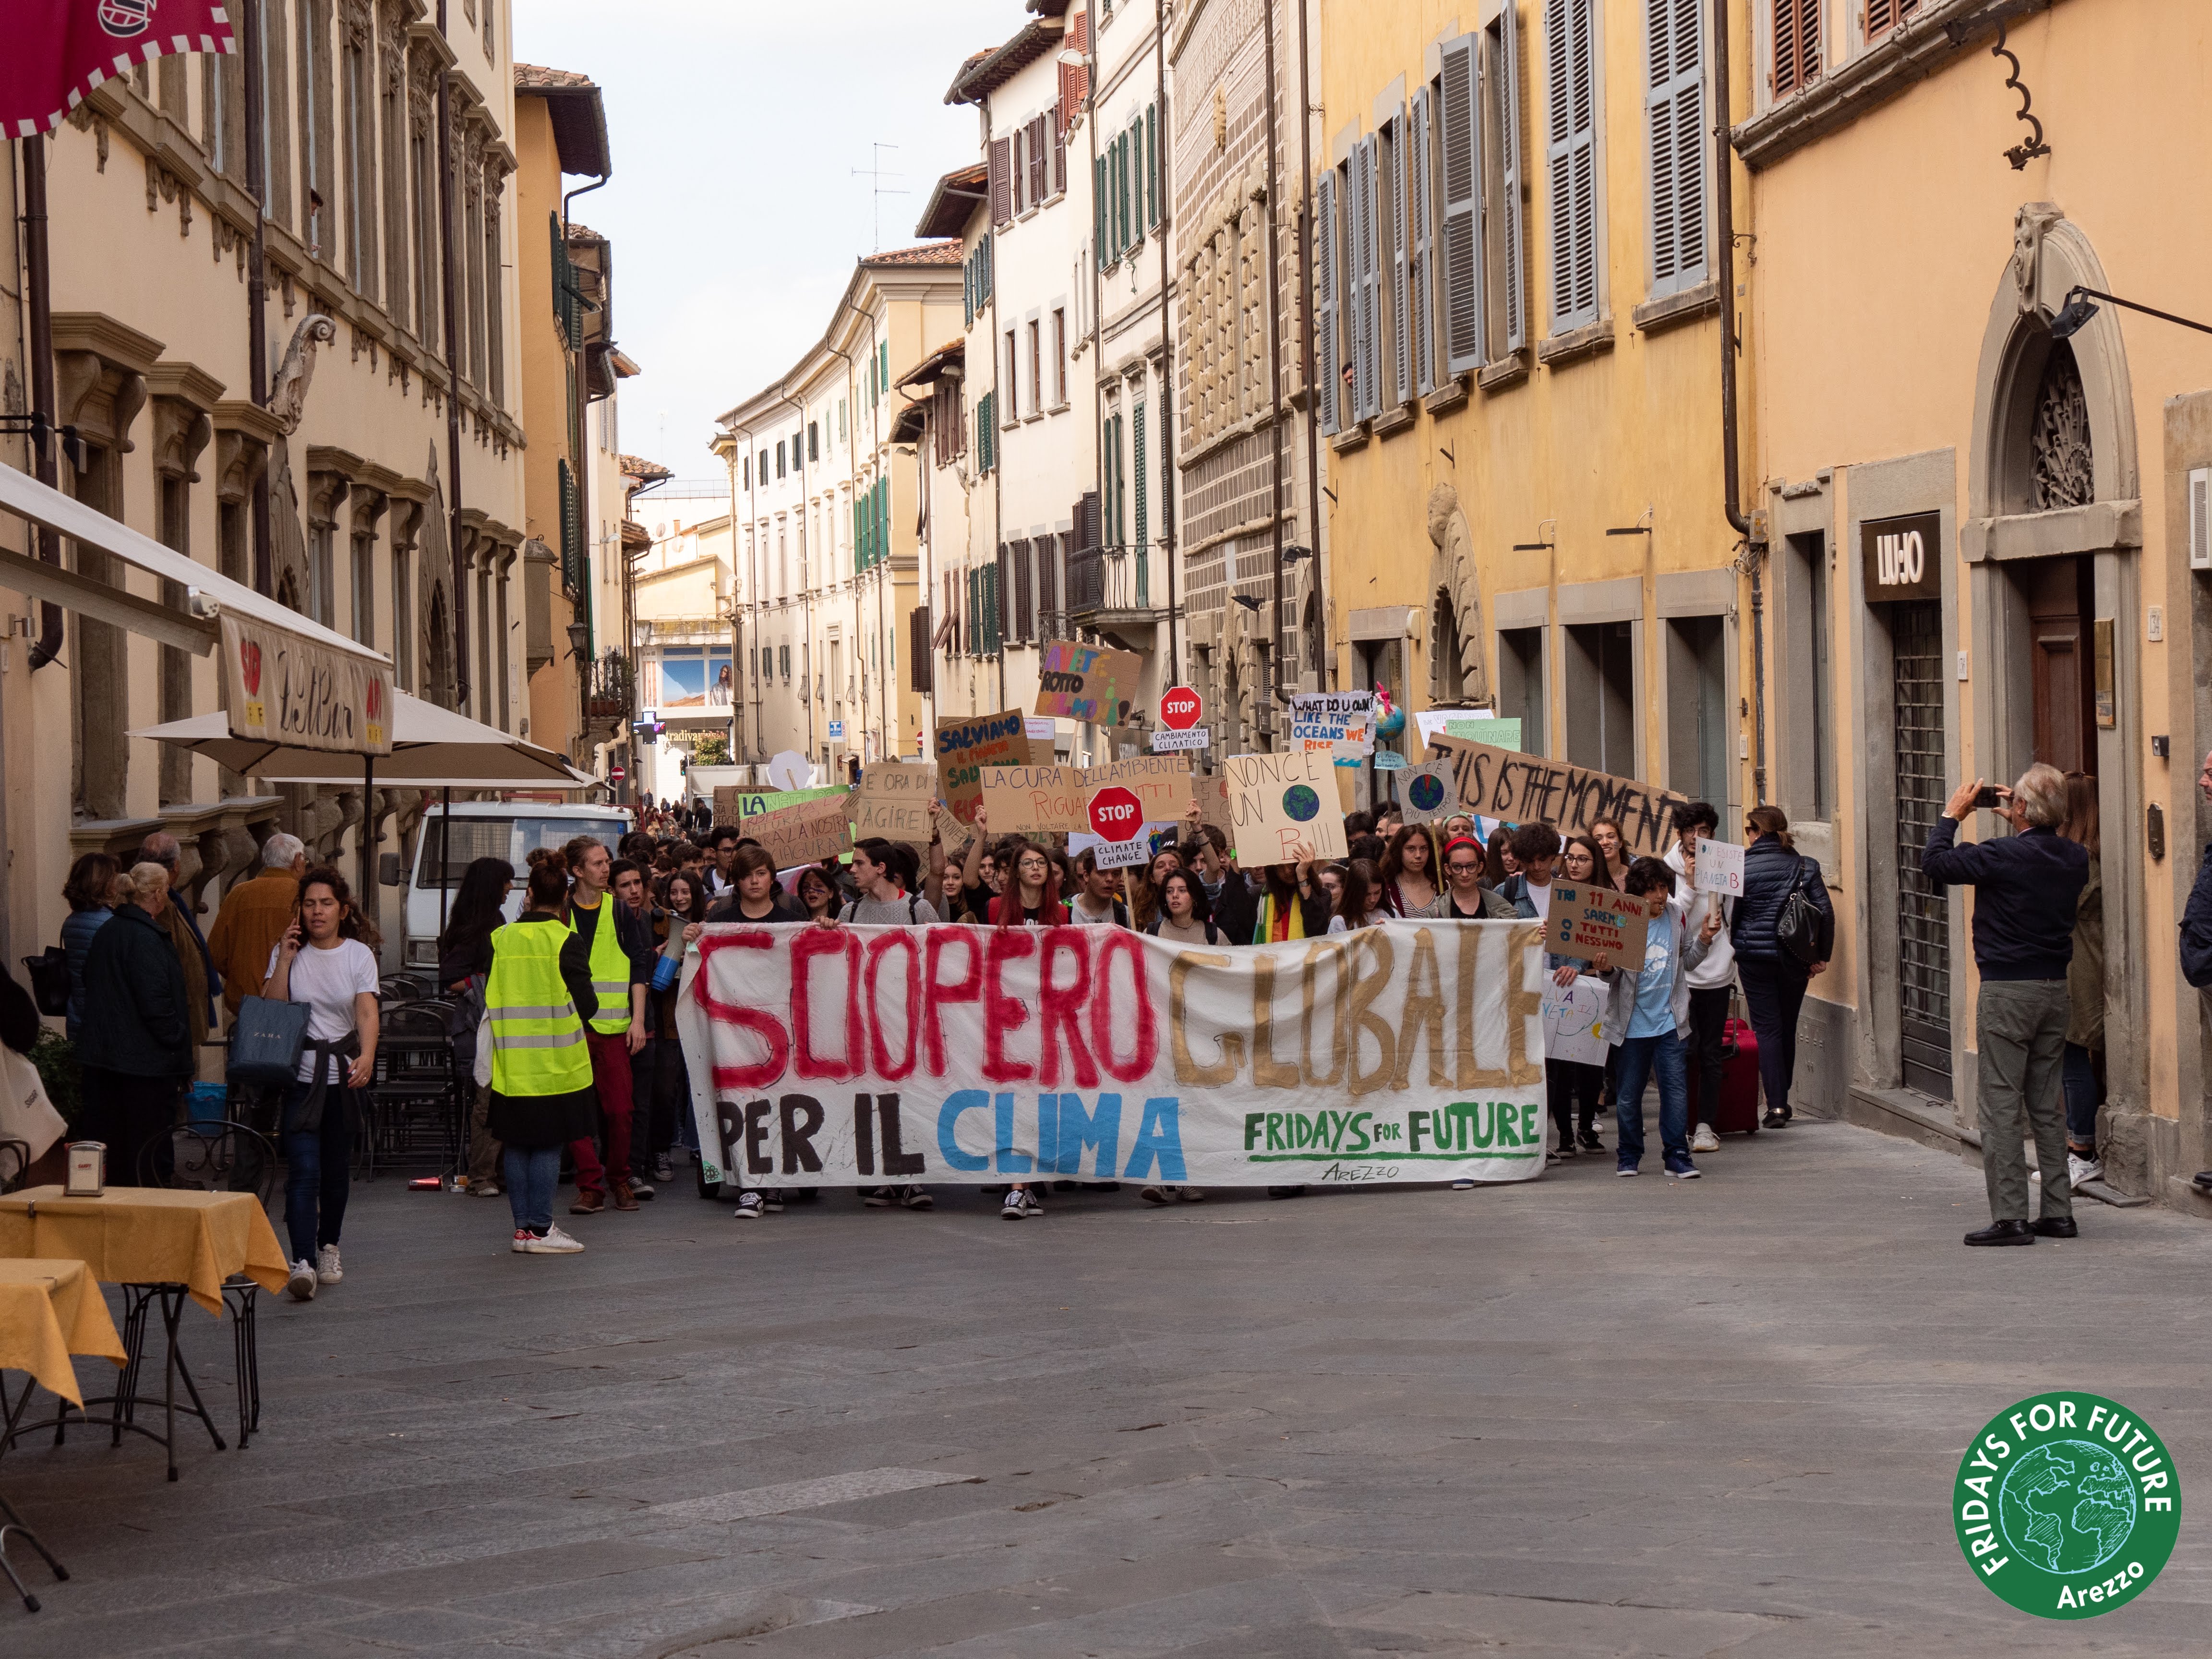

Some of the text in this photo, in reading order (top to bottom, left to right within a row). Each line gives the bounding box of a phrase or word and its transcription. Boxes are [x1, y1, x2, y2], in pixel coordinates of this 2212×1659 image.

[1045, 646, 1111, 677] AVETE
[1041, 671, 1084, 694] ROTTO
[1167, 701, 1195, 714] STOP
[1291, 696, 1374, 712] WHAT DO U OWN?
[1294, 712, 1351, 726] LIKE THE
[1449, 721, 1475, 730] NON
[939, 715, 1021, 754] SALVIAMO
[1155, 731, 1206, 741] CAMBIAMENTO
[1293, 726, 1364, 742] OCEANS WE
[957, 740, 1009, 764] IL PIANETA
[1159, 739, 1203, 749] CLIMATICO
[1304, 739, 1334, 753] RISE
[884, 773, 910, 791] ORA
[984, 769, 1007, 788] LA
[1010, 767, 1063, 789] CURA
[1224, 757, 1280, 789] NON
[1397, 768, 1418, 785] NON
[743, 796, 766, 816] LA
[824, 794, 843, 807] LA
[1029, 791, 1093, 821] RIGUAR
[1230, 789, 1263, 827] UN
[1491, 754, 1520, 813] IS
[1518, 762, 1567, 824] THE
[1558, 768, 1687, 854] MOMENT
[713, 805, 726, 815] STA
[1098, 804, 1135, 823] STOP
[713, 815, 741, 829] PERCH
[744, 812, 803, 836] NATURA
[787, 824, 807, 844] LA
[812, 815, 849, 838] NOSTRA
[1016, 823, 1031, 831] NON
[1037, 822, 1069, 831] VOLTARE
[1098, 841, 1142, 855] CLIMATE
[1717, 847, 1743, 862] ESISTE
[1102, 853, 1142, 866] CHANGE
[1709, 859, 1724, 869] UN
[1695, 867, 1739, 889] PIANETA B
[1555, 888, 1643, 917] TRA 11 ANNI
[1580, 921, 1619, 938] TUTTI
[1575, 933, 1624, 951] NESSUNO
[694, 921, 1544, 1095] SCIOPERO GLOBALE
[716, 1089, 1187, 1181] PER IL CLIMA
[1244, 1102, 1540, 1153] FRIDAYS FOR FUTURE
